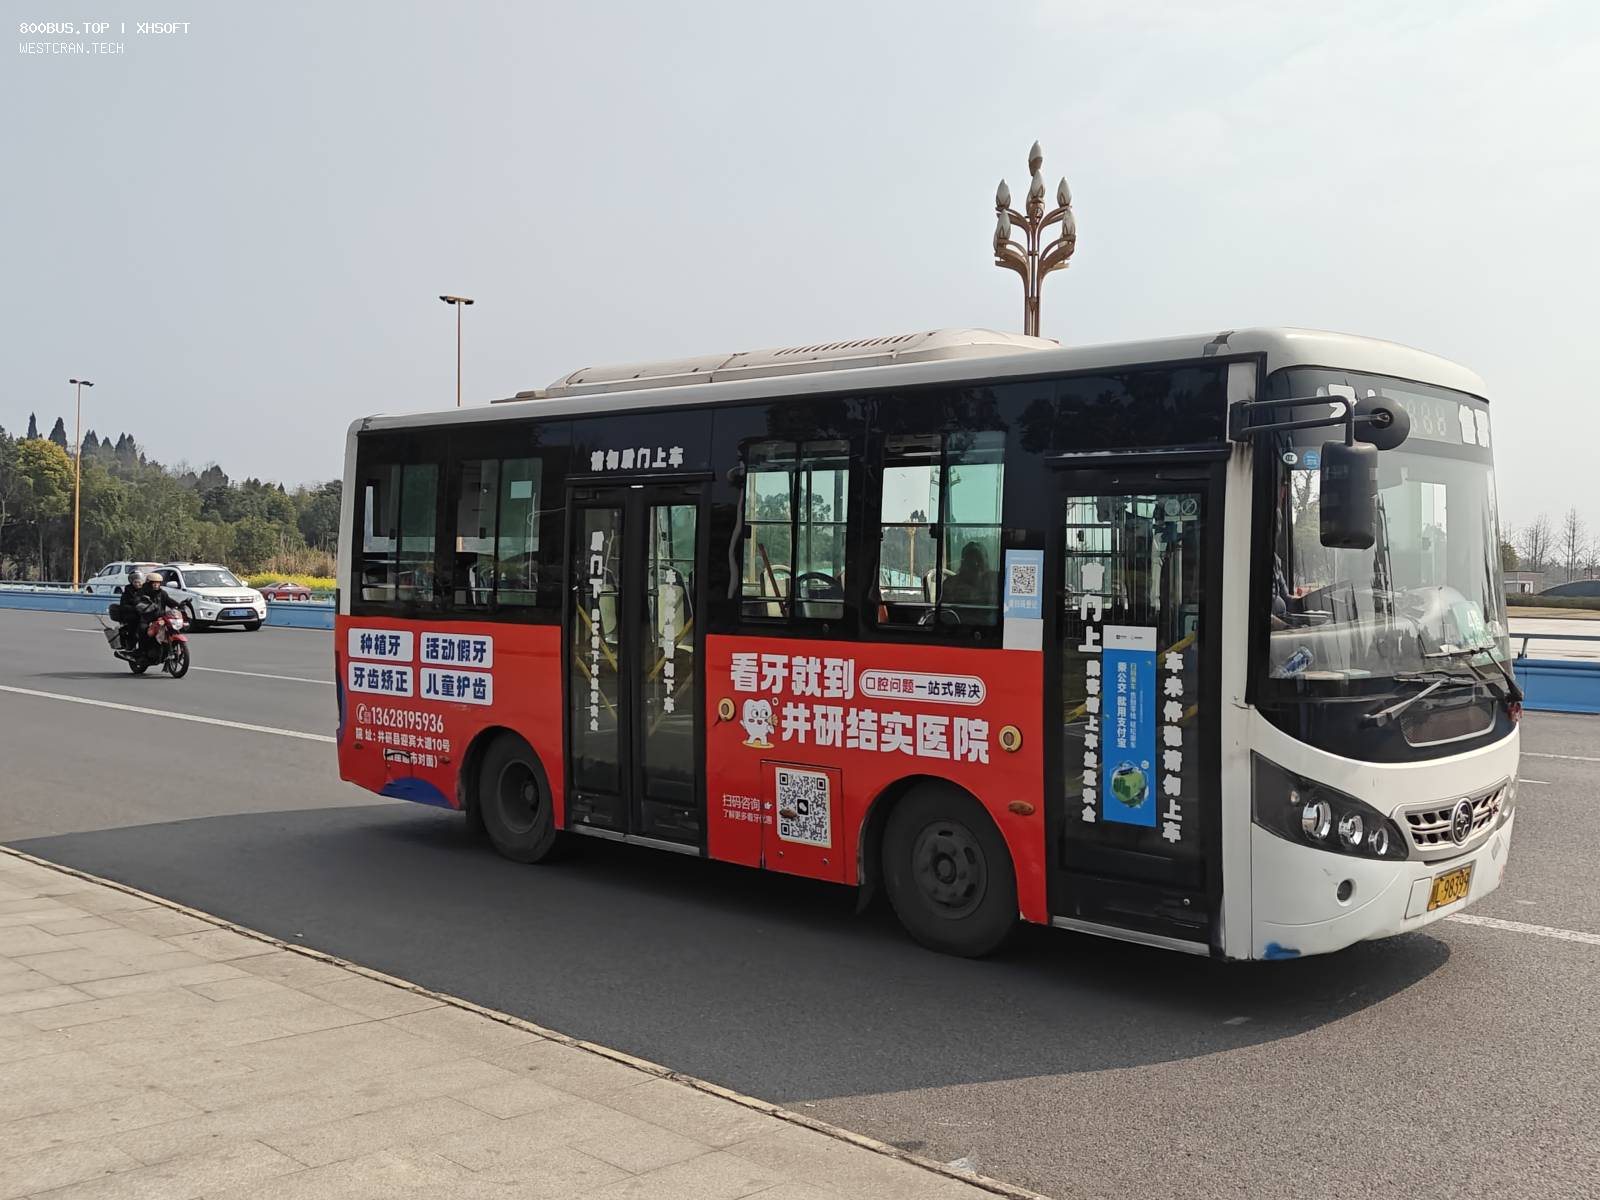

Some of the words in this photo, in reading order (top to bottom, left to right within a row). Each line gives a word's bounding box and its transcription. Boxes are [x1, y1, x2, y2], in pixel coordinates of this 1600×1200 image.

[360, 632, 401, 656] 种植牙
[426, 637, 487, 663] 活动假牙
[353, 666, 408, 692] 牙齿矫正
[426, 673, 487, 700] 儿童护齿
[730, 652, 855, 699] 看牙就到
[865, 675, 981, 699] 口腔问题一站式解决
[371, 706, 444, 733] 13628195936
[781, 702, 990, 764] 井研结实医院
[722, 793, 760, 811] 扫码咨询
